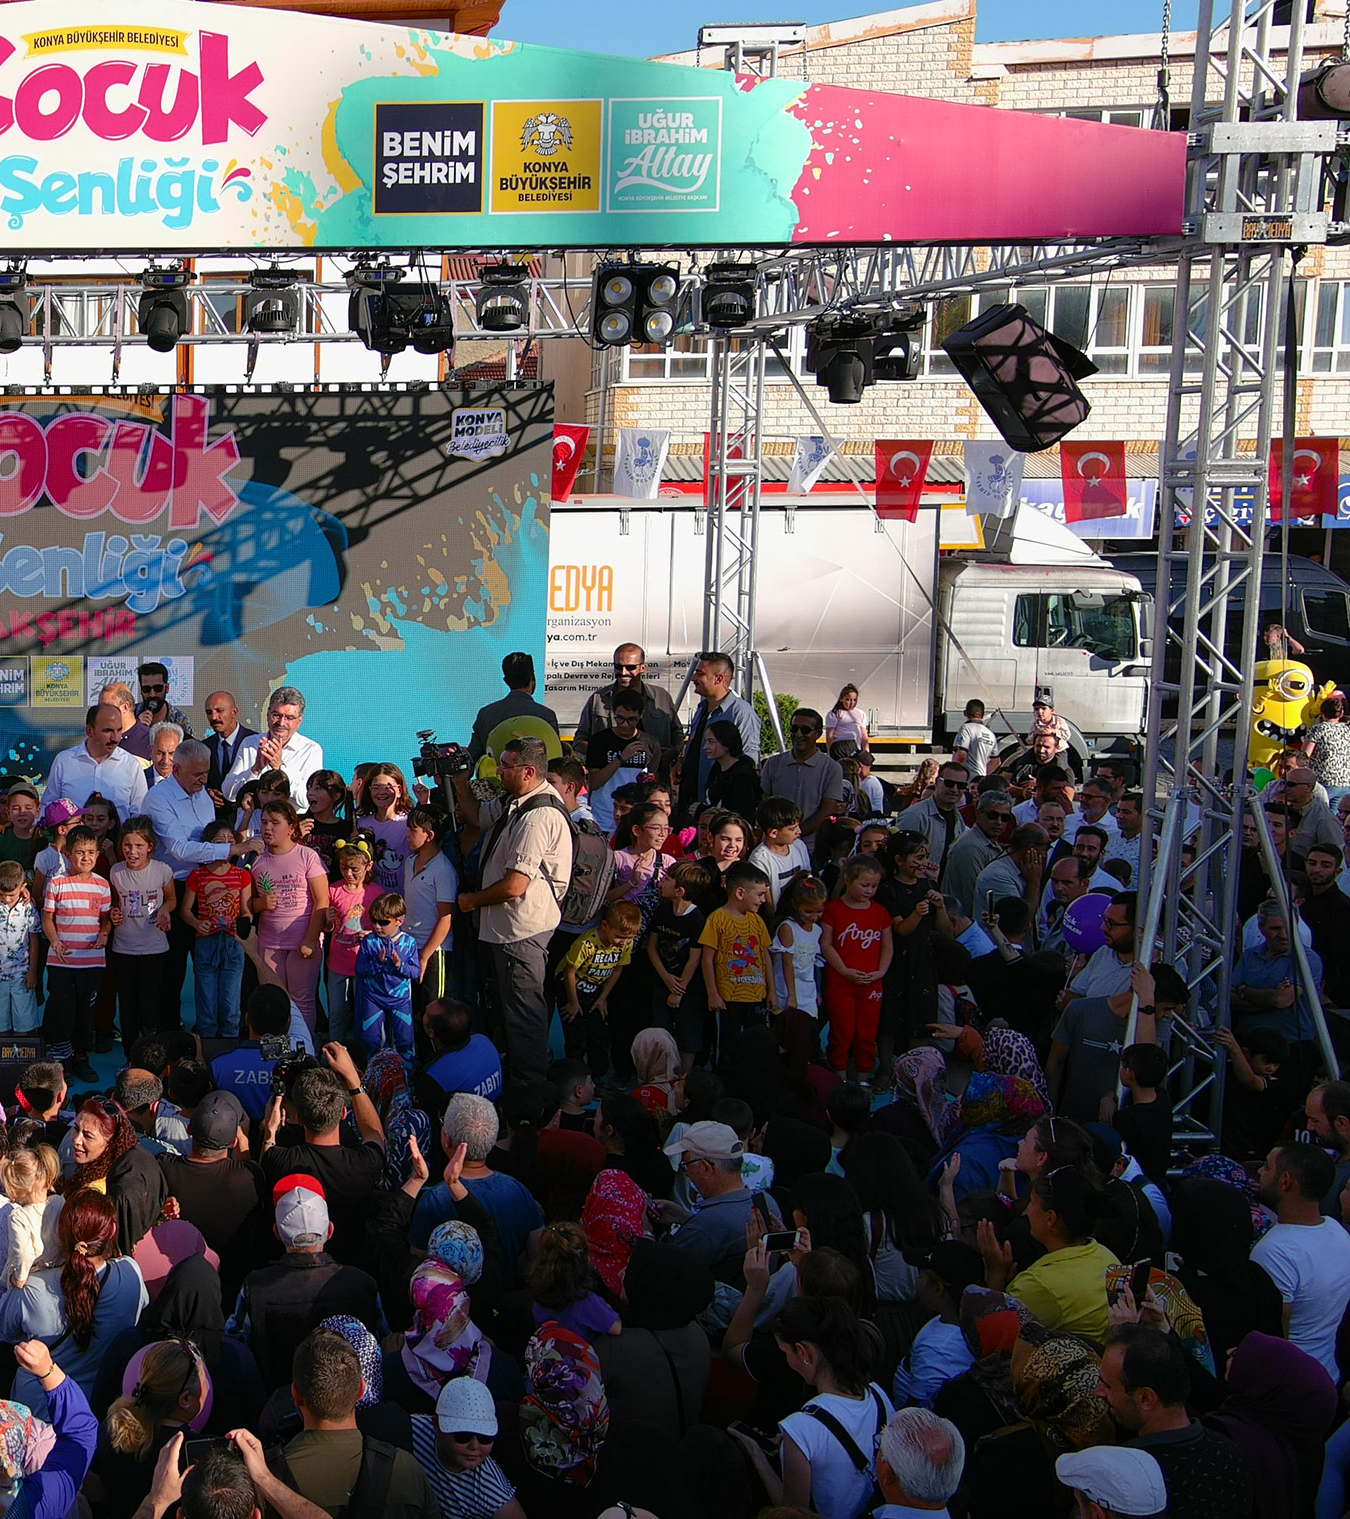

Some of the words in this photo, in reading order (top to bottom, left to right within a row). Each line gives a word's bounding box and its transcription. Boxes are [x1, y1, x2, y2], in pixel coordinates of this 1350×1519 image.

[33, 34, 64, 49] KONYA
[66, 29, 124, 45] BÜYÜKŞEHİR
[126, 31, 179, 48] BELEDİYESİ
[638, 109, 694, 128] UĞUR
[523, 162, 569, 173] KONYA
[614, 145, 713, 194] Altay
[500, 173, 592, 193] BÜYÜKŞEHİR
[518, 191, 573, 202] BELEDİYESİ
[455, 412, 503, 426] KONYA
[447, 435, 510, 455] Belediyecilik
[550, 565, 614, 612] EDYA
[547, 616, 612, 628] rganizasyon
[546, 633, 598, 644] ya.com.tr
[100, 659, 127, 670] UĞUR
[546, 672, 563, 680] palı
[564, 672, 589, 680] Devre
[544, 684, 577, 692] Tasarım
[578, 684, 599, 692] Hizm
[594, 953, 620, 963] RELAX
[234, 1069, 272, 1085] ZAB
[473, 1071, 501, 1098] ZABIT
